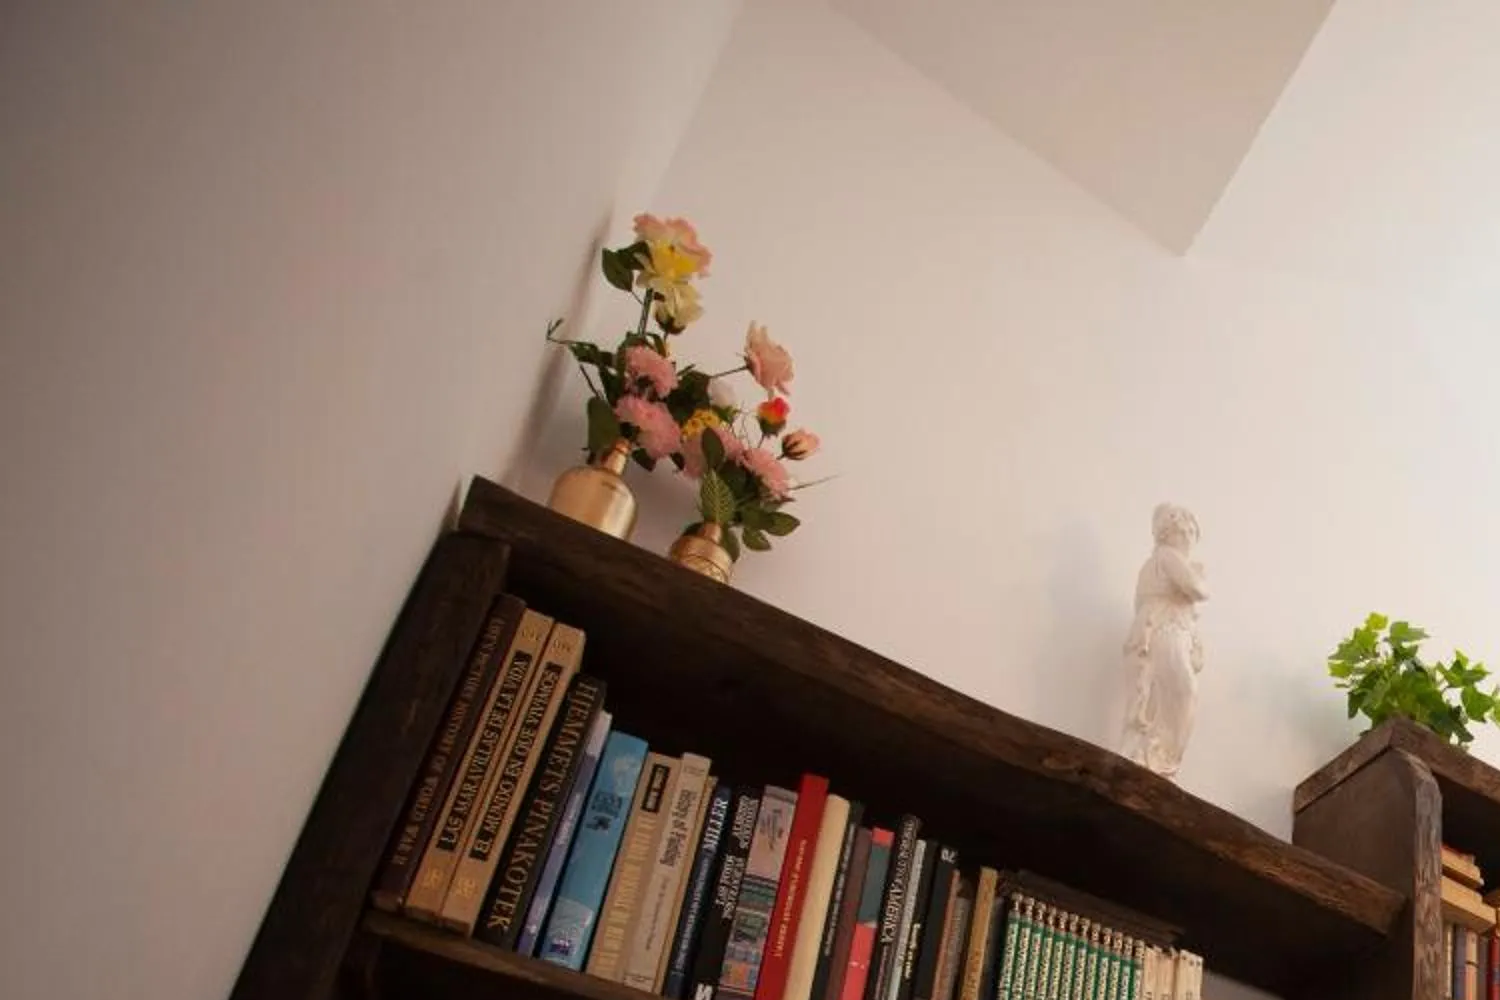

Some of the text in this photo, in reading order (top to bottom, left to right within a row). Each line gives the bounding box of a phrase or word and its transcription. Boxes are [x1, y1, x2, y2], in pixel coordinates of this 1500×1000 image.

[525, 669, 559, 726] VIVIMOS
[440, 657, 527, 845] LAS MARAVILLAS DE LA VIDA
[504, 757, 523, 777] EN
[513, 726, 536, 757] QUE
[481, 778, 515, 834] MUNDO
[702, 796, 729, 852] MILLER
[471, 833, 487, 852] EL
[485, 795, 557, 935] PINAKOTEK
